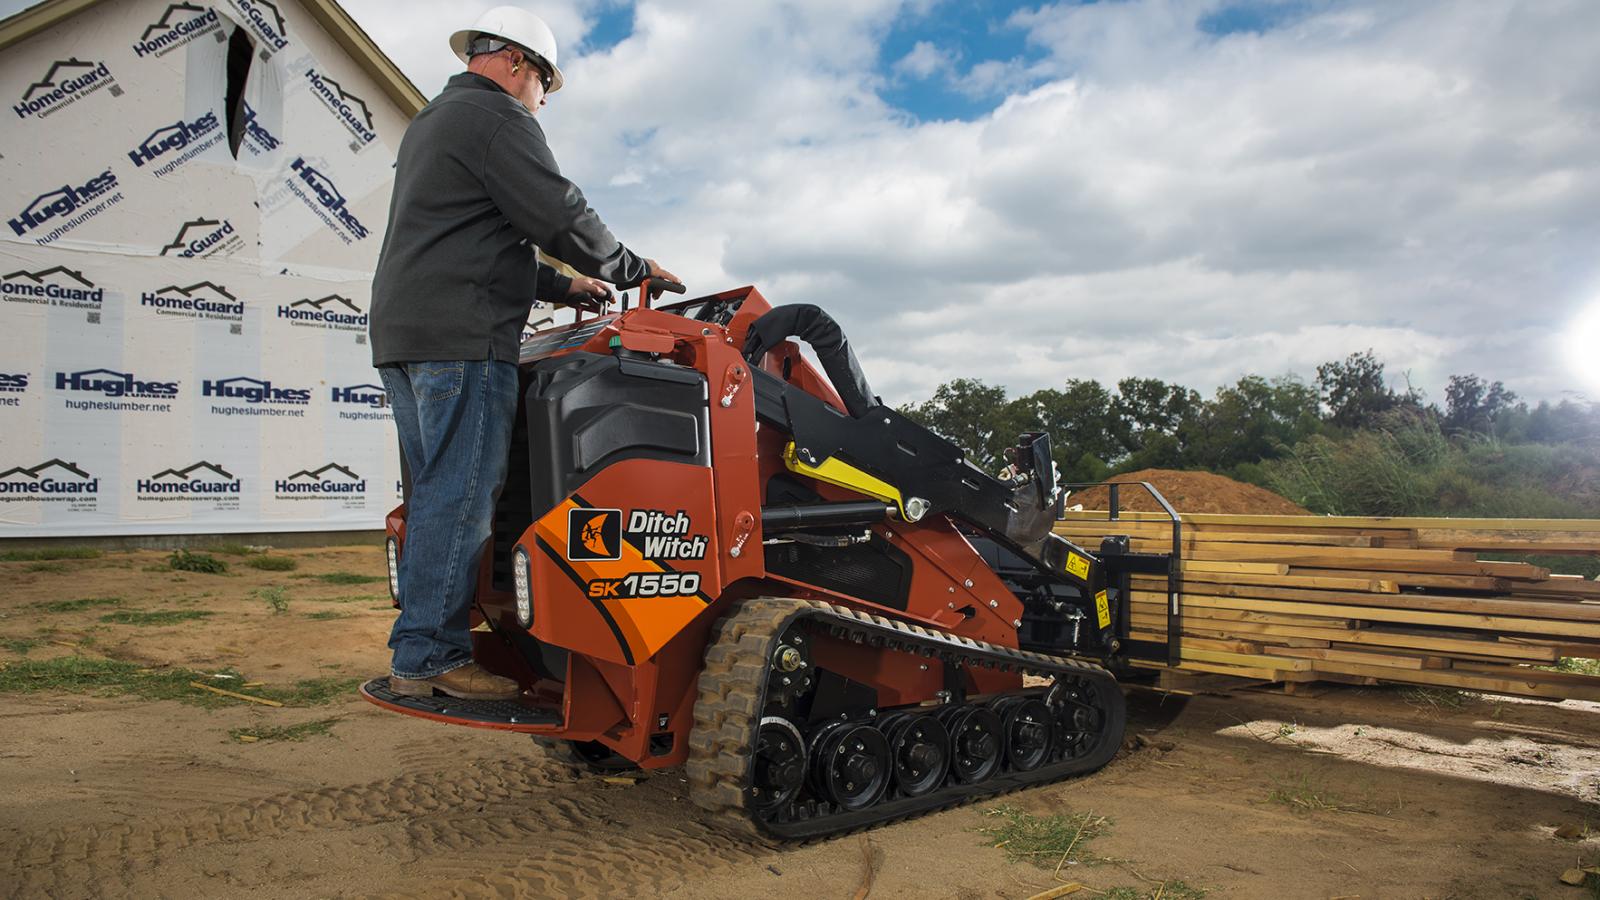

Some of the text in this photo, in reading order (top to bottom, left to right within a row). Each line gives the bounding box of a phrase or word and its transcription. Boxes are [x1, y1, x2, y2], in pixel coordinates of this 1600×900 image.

[132, 7, 218, 58] HomeGuard
[237, 0, 288, 50] eGuard
[12, 62, 110, 119] HomeGuard
[37, 97, 76, 119] Commercial
[80, 76, 116, 96] Residential
[305, 68, 376, 142] HomeGuard
[128, 111, 218, 167] Hughes
[153, 132, 226, 178] hugheslumber.net
[7, 170, 116, 236] Hughes
[76, 182, 119, 208] LUMBER
[291, 157, 369, 238] Hughes
[36, 192, 124, 246] hugheslumber.net
[286, 178, 352, 246] hugheslumber.net
[178, 220, 234, 258] eGuard
[0, 279, 103, 302] omeGuard
[3, 295, 49, 305] Commercial
[59, 300, 102, 310] Residential
[141, 292, 244, 314] HomeGuard
[156, 309, 196, 318] Commercial
[206, 312, 243, 321] Residential
[278, 305, 368, 326] HomeGuard
[290, 320, 326, 328] Commercial
[334, 324, 368, 332] Residential
[56, 371, 179, 397] Hughes
[202, 379, 312, 404] Hughes
[66, 400, 171, 412] hugheslumber.net
[332, 387, 392, 408] Hug
[212, 406, 304, 418] hugheslumber.net
[137, 479, 240, 492] HomeGuard
[275, 480, 366, 492] HomeGuard
[628, 511, 690, 534] Ditch
[644, 536, 706, 558] Witch
